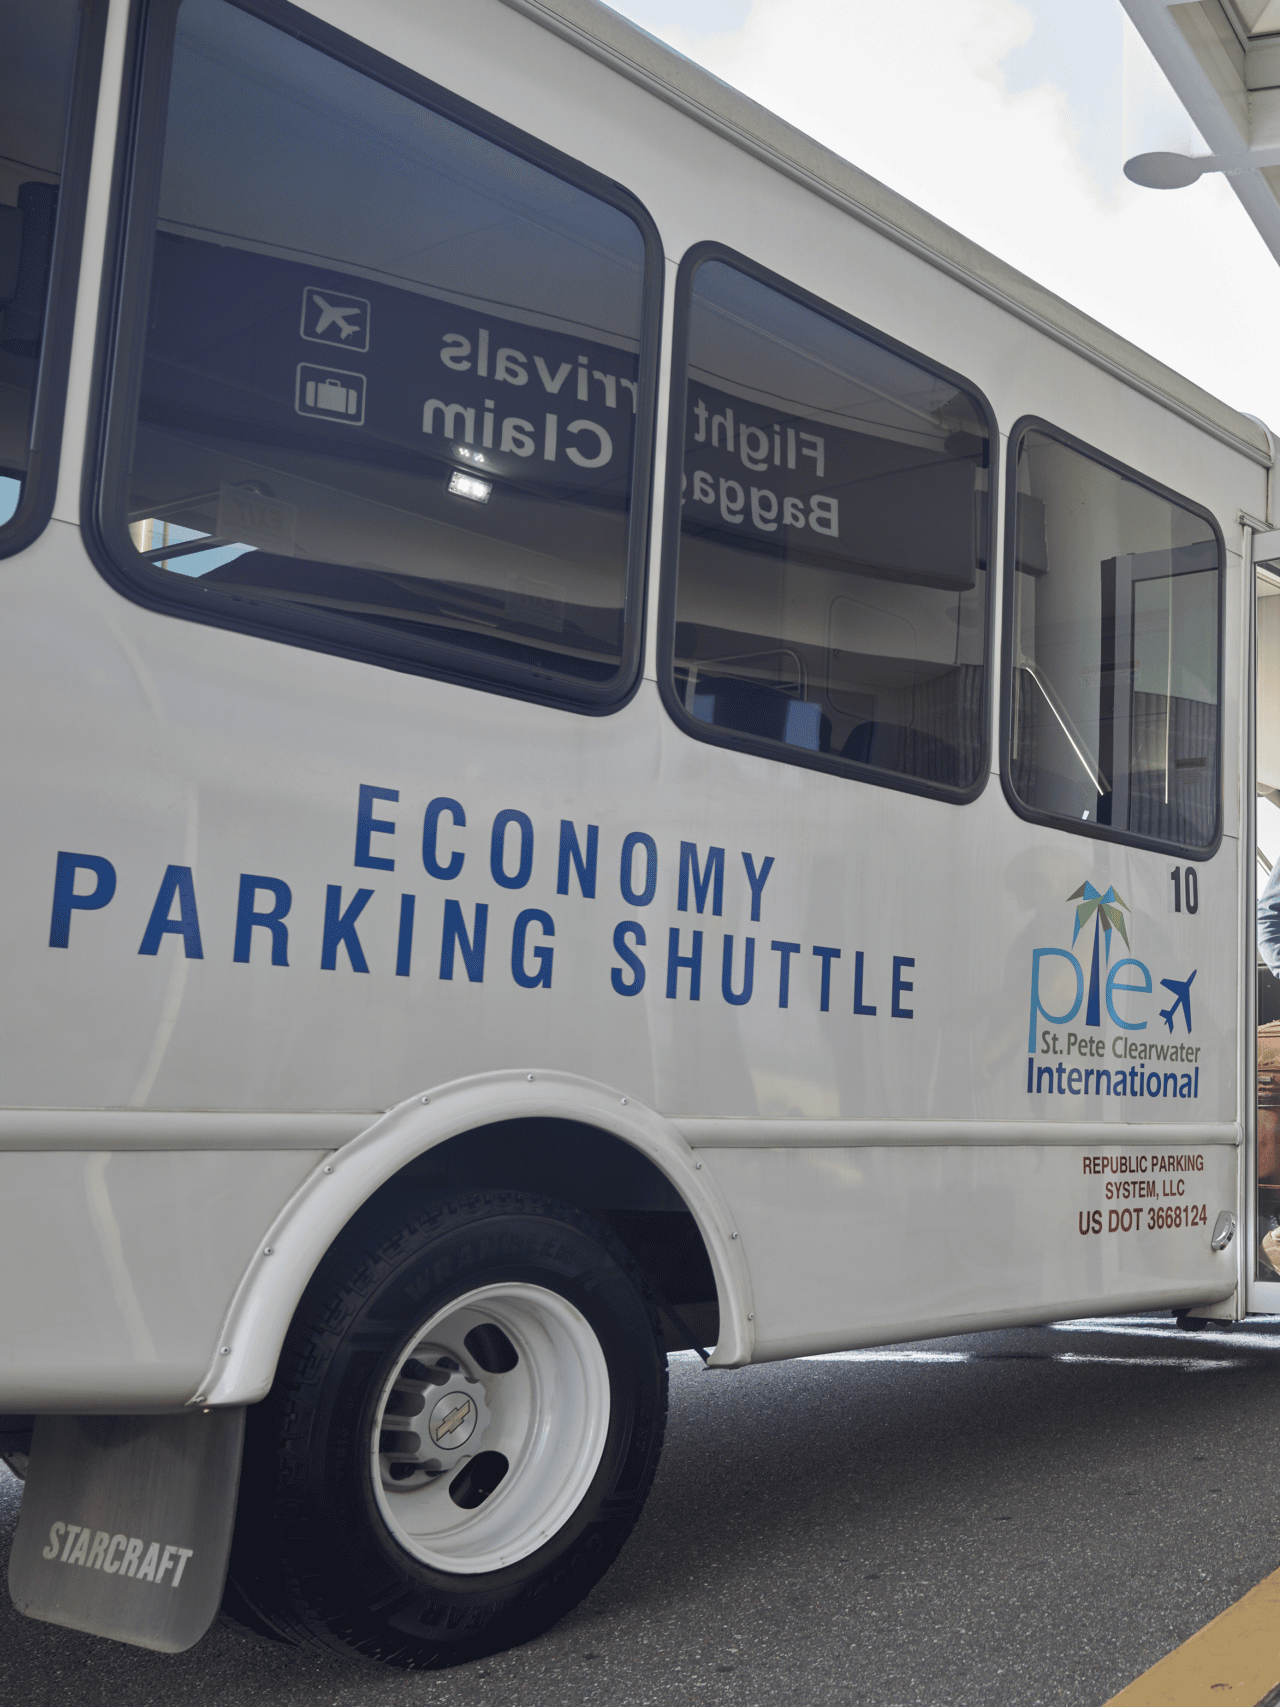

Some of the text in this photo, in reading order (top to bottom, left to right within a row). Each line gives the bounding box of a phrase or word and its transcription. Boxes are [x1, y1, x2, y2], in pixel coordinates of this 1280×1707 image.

[355, 785, 774, 921] ECONOMY
[1170, 865, 1199, 915] 10
[50, 852, 914, 1017] PARKING SHUTTLE
[1040, 1029, 1201, 1063] St. Pete Clearwater
[1027, 1056, 1200, 1099] International
[1083, 1154, 1204, 1175] REPUBLIC PARKING
[1104, 1179, 1185, 1200] SYSTEM, LLC
[1079, 1203, 1208, 1236] US DOT 3668124
[404, 1233, 578, 1302] WRANGLER
[42, 1520, 194, 1588] STARCRAFT
